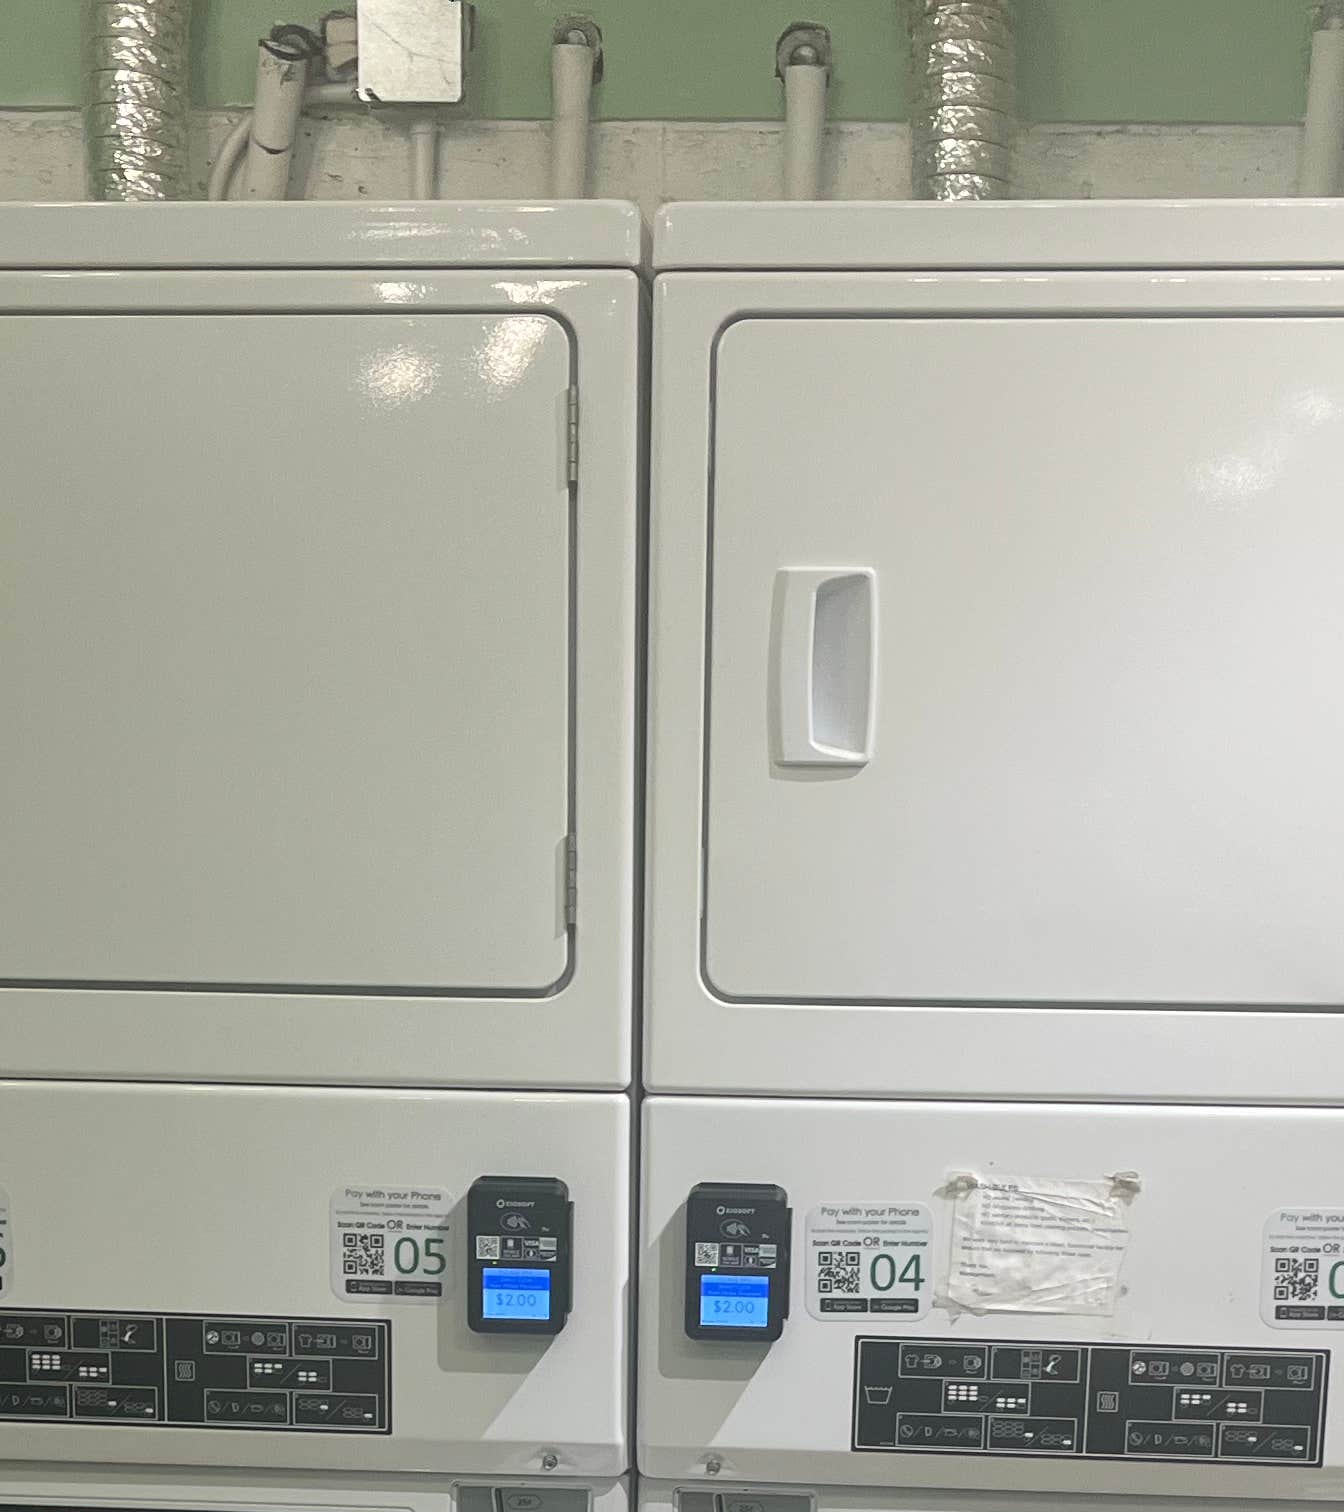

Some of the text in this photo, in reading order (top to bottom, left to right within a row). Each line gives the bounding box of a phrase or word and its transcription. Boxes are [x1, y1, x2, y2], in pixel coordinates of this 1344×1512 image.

[345, 1189, 441, 1201] Pay with your Phone
[821, 1207, 919, 1218] Pay with your Phone
[1280, 1213, 1300, 1224] Pay
[1306, 1213, 1325, 1223] with
[387, 1219, 403, 1230] OR
[863, 1237, 880, 1247] OR
[1323, 1243, 1340, 1254] OR
[394, 1237, 446, 1275] 05
[869, 1253, 925, 1292] 04
[495, 1294, 536, 1307] $2.00
[713, 1300, 754, 1314] $2.00
